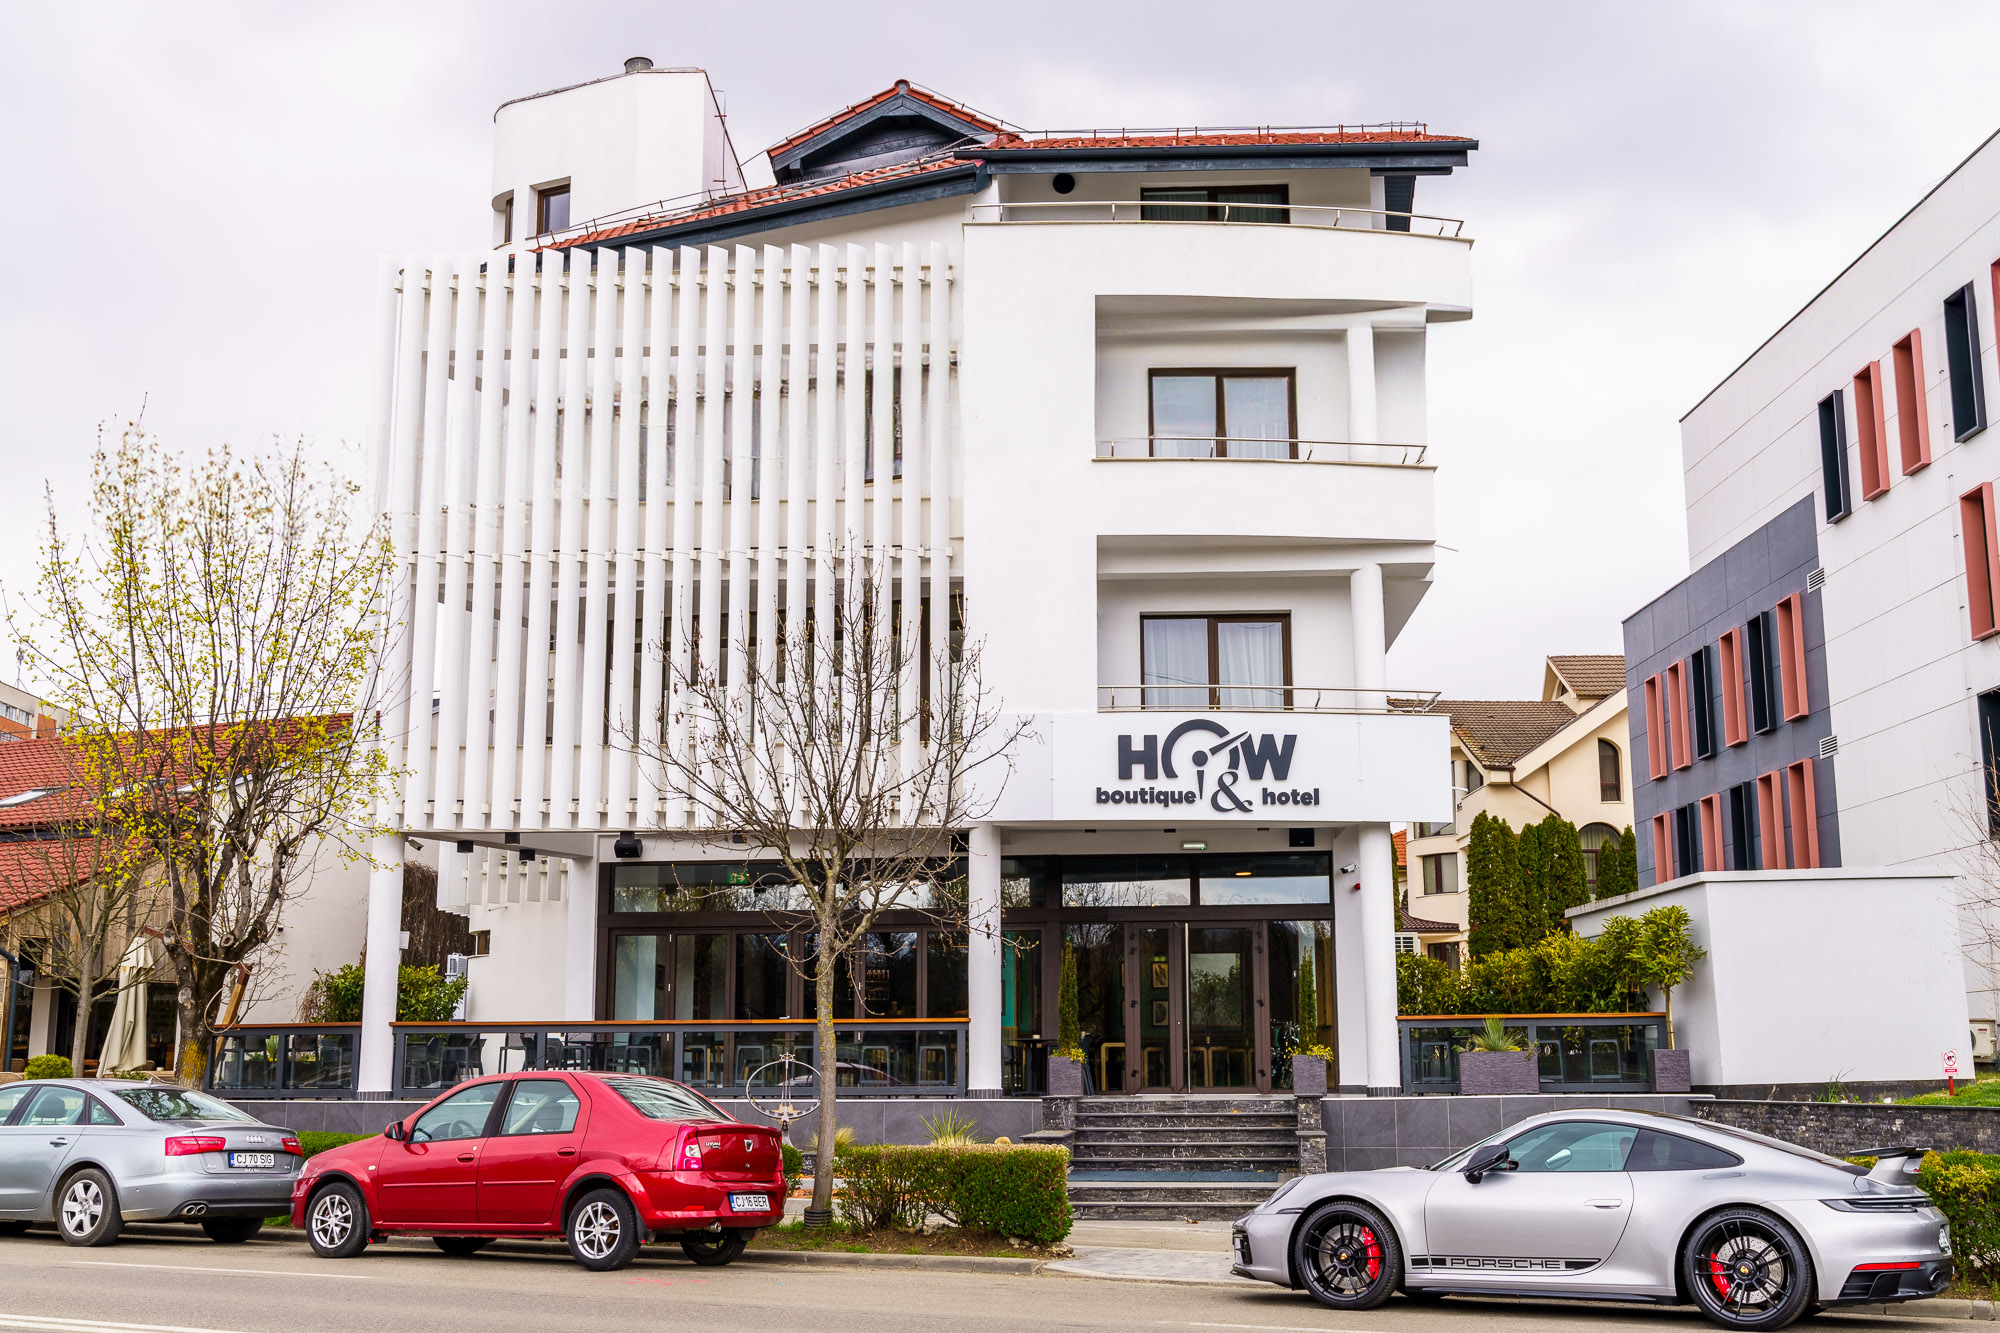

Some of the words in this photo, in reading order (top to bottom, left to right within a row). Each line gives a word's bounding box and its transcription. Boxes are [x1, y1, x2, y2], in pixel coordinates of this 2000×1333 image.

[1118, 718, 1298, 780] HOW
[1096, 787, 1197, 807] boutique
[1210, 771, 1254, 812] &
[1262, 787, 1320, 806] hotel
[236, 1154, 247, 1164] CJ
[249, 1154, 258, 1164] 70
[260, 1154, 272, 1164] SIG
[735, 1196, 745, 1207] CJ
[745, 1196, 753, 1207] 16
[753, 1196, 768, 1207] BER
[1450, 1257, 1561, 1270] PORSCHE
